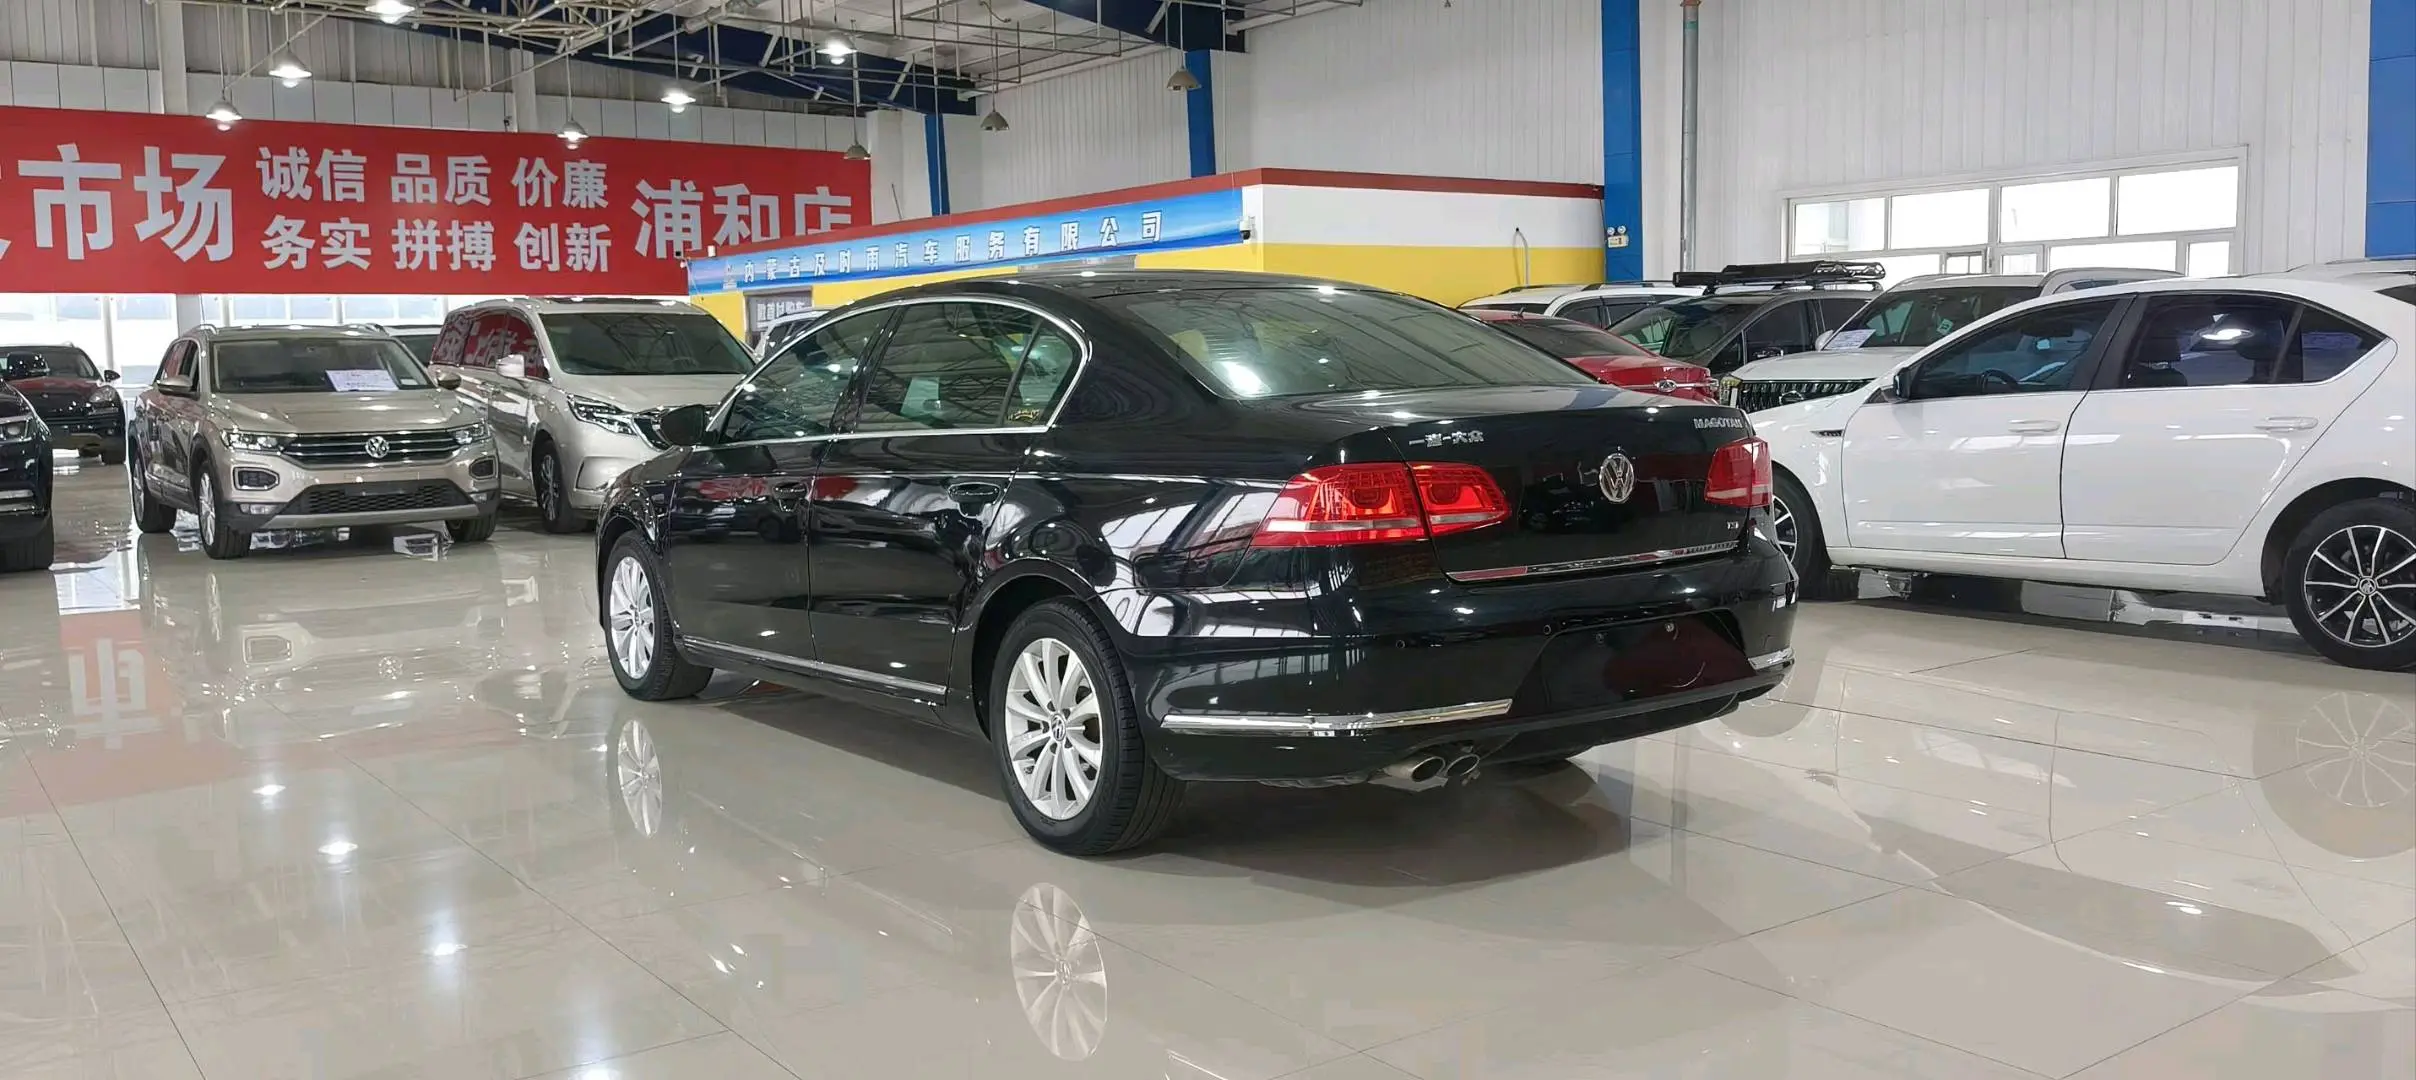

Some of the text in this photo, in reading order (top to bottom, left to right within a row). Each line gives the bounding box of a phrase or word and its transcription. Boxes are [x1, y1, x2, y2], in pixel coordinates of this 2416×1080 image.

[0, 142, 234, 263] 市场
[255, 146, 610, 209] 诚信 品质 价廉
[260, 214, 613, 273] 务实 拼搏 创新
[630, 179, 852, 260] 浦和店
[743, 210, 1162, 284] 内蒙古及时雨汽车服务有限公司
